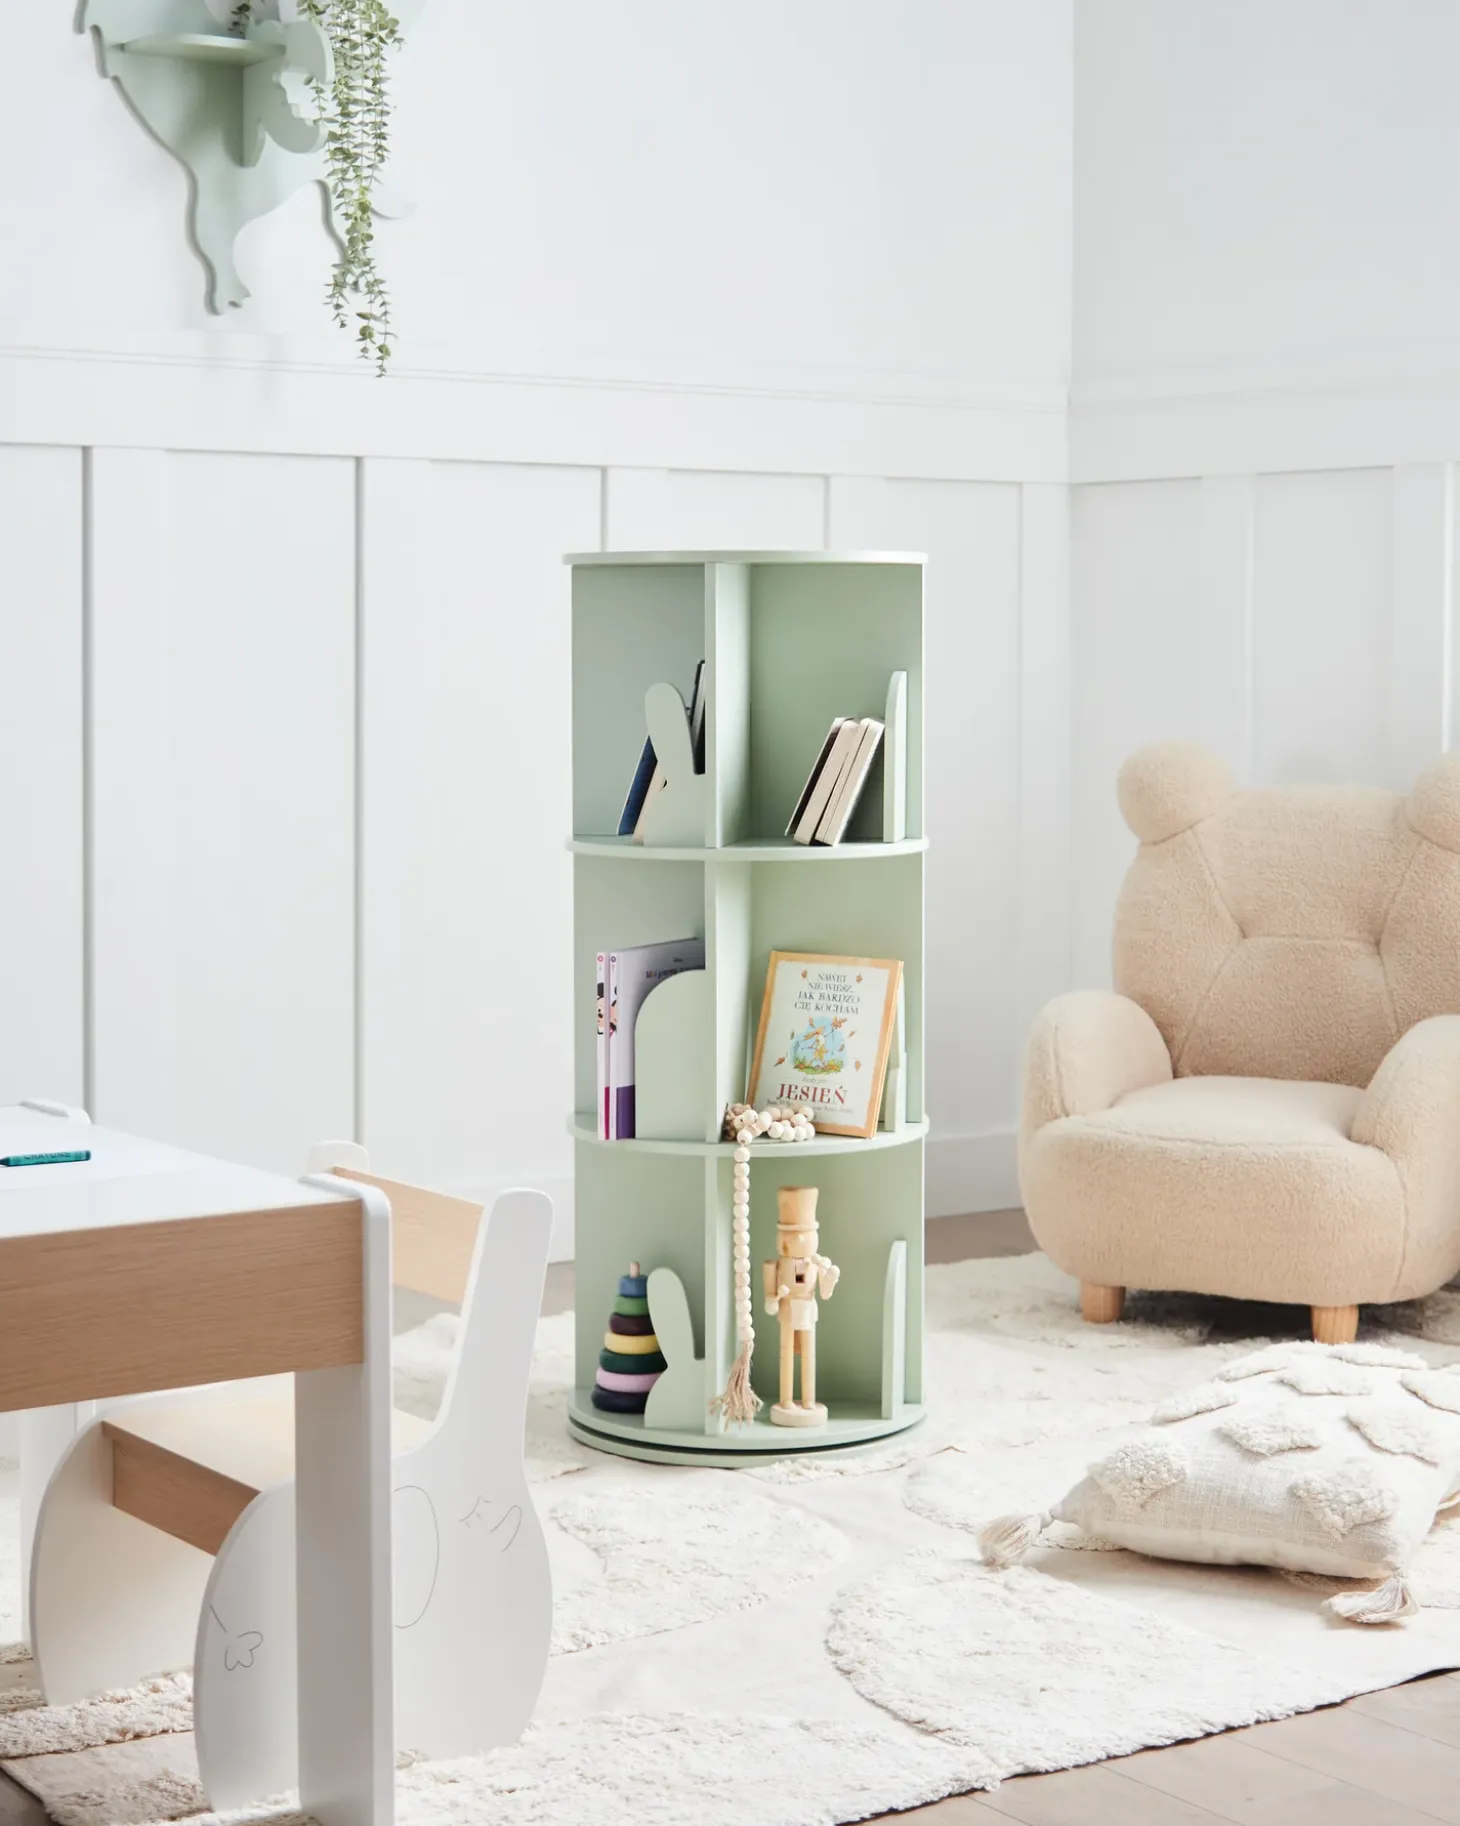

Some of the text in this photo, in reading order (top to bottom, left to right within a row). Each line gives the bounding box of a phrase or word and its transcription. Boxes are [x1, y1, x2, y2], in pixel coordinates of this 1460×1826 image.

[817, 973, 848, 983] NAWET
[808, 982, 824, 991] NIE
[797, 990, 860, 1003] JAK BARDZO
[814, 1003, 859, 1015] KOCHAM
[776, 1083, 848, 1105] JESIEŃ
